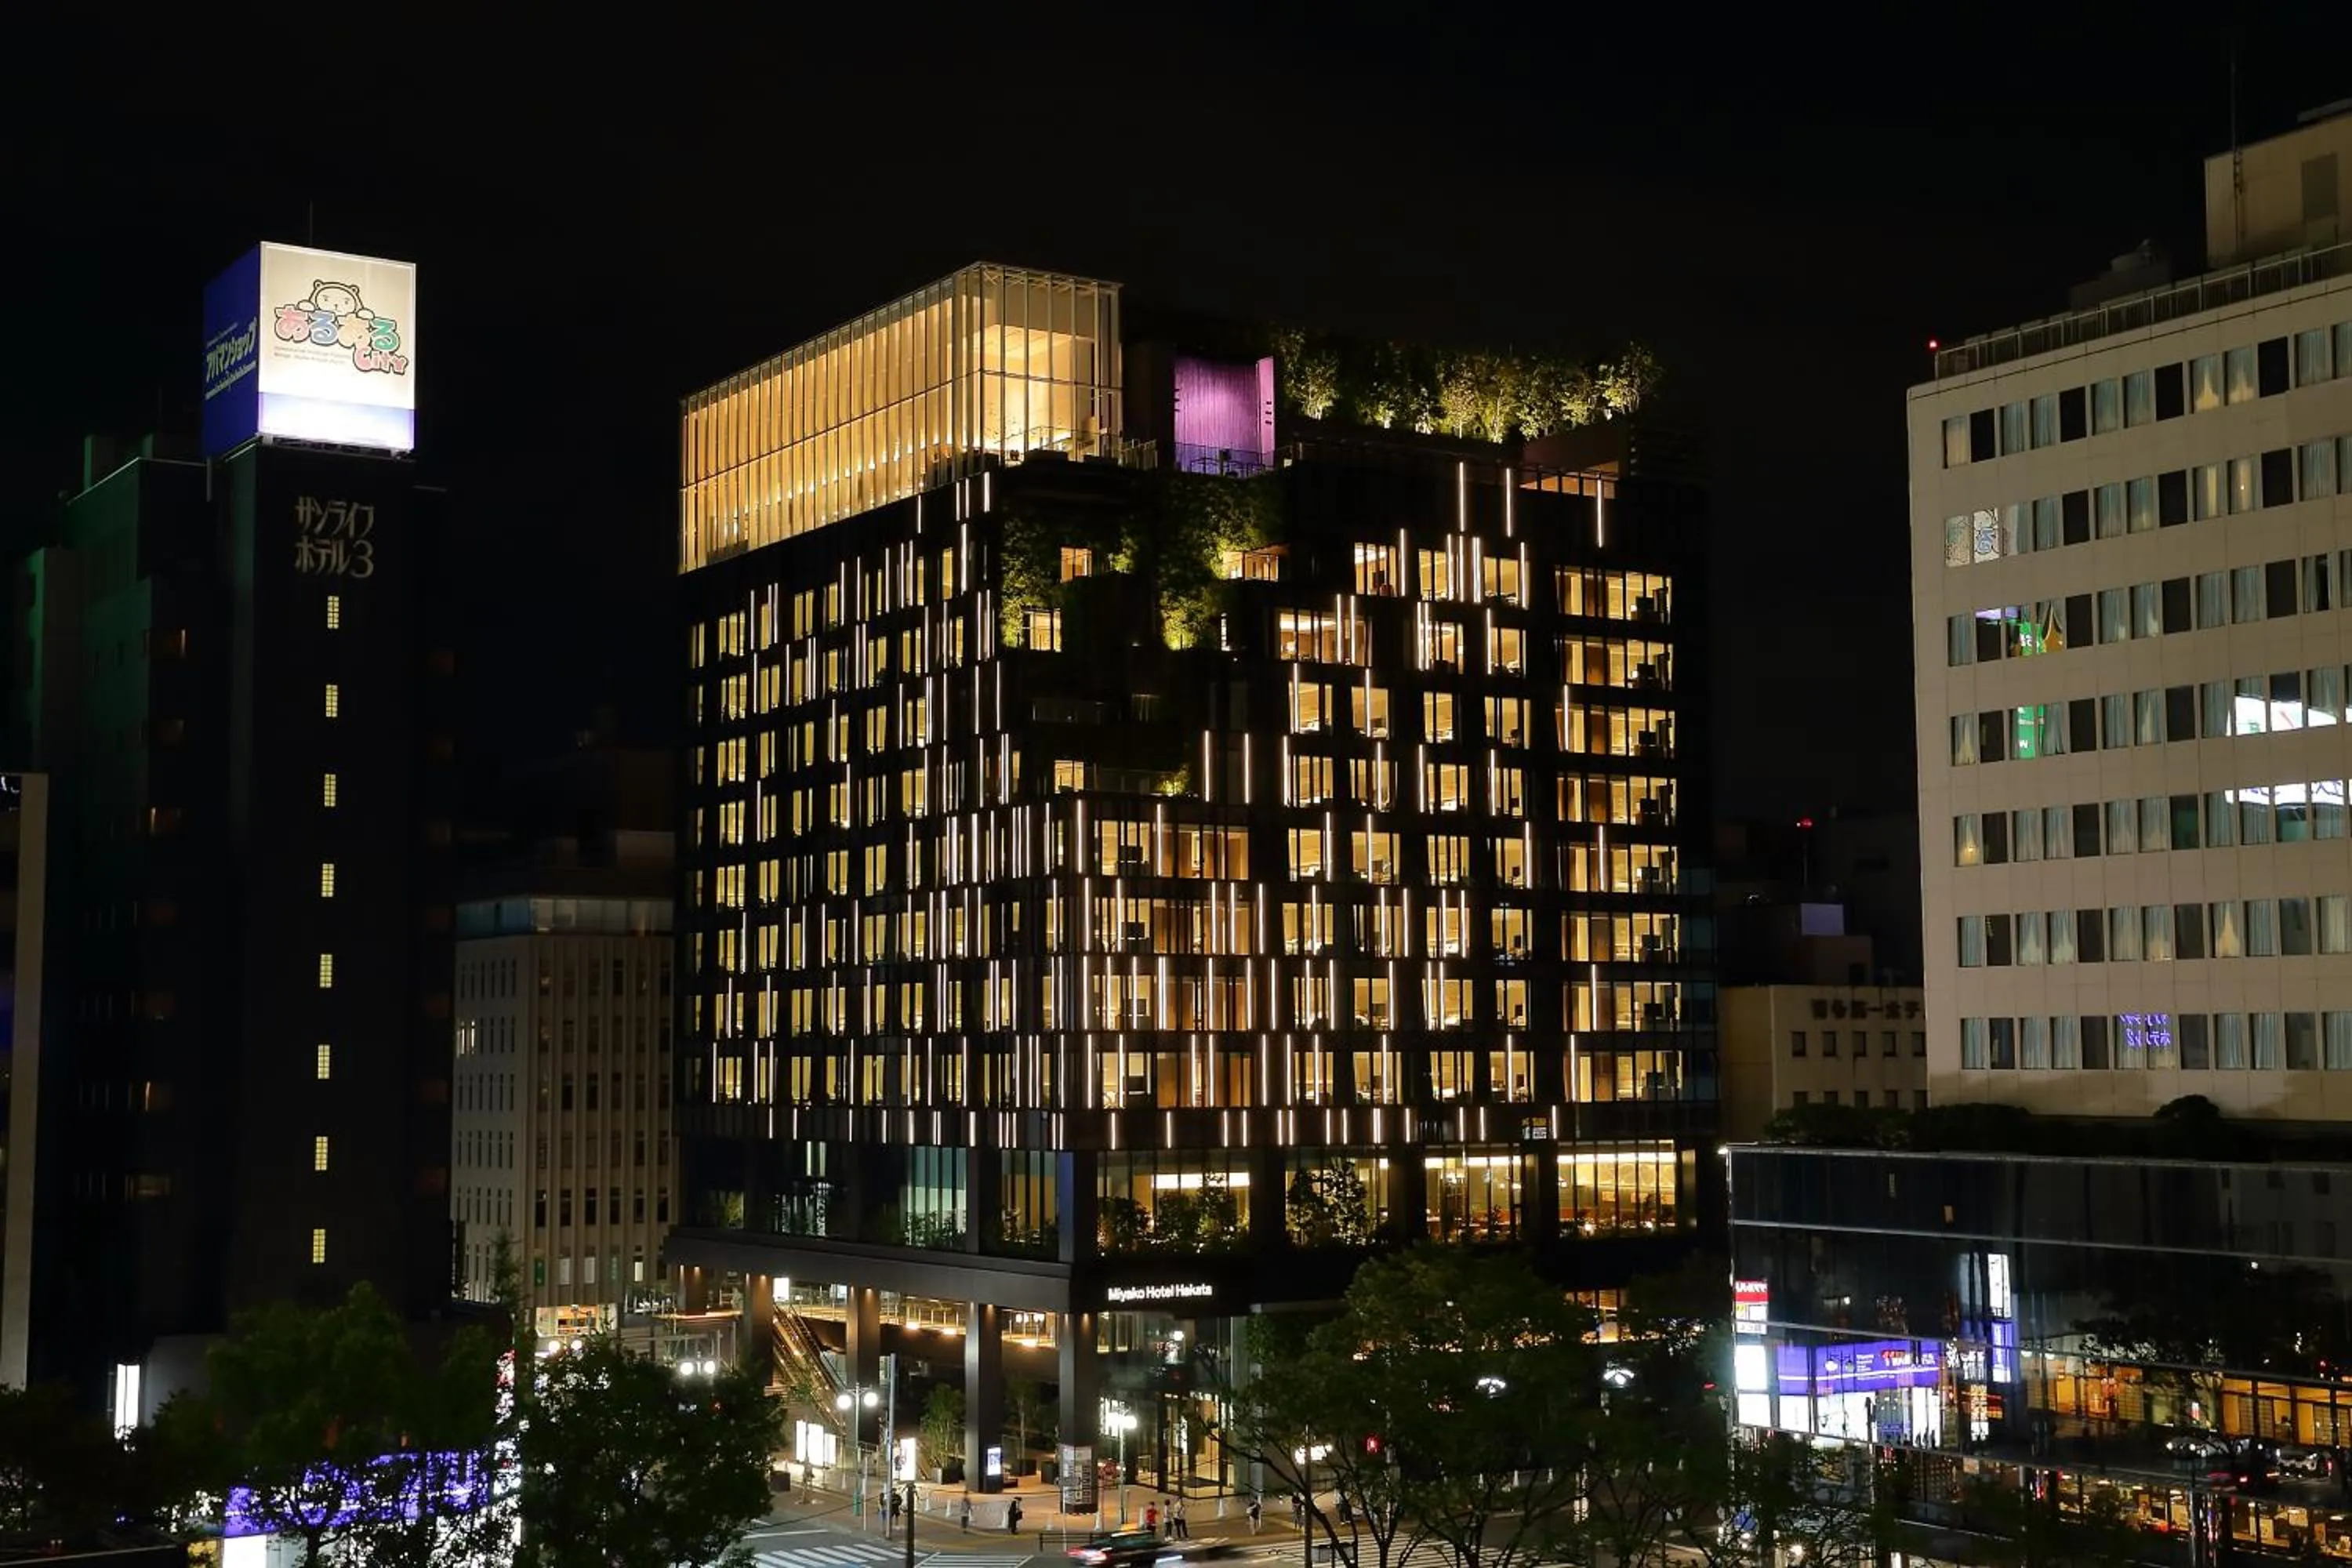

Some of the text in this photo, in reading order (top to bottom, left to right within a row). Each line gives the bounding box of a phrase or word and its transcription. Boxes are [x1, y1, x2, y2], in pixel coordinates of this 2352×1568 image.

[275, 304, 401, 352] あるある
[295, 496, 375, 539] サンライフ
[295, 535, 374, 578] ホテル3
[1107, 1283, 1212, 1302] Miyako Hotel Hakata
